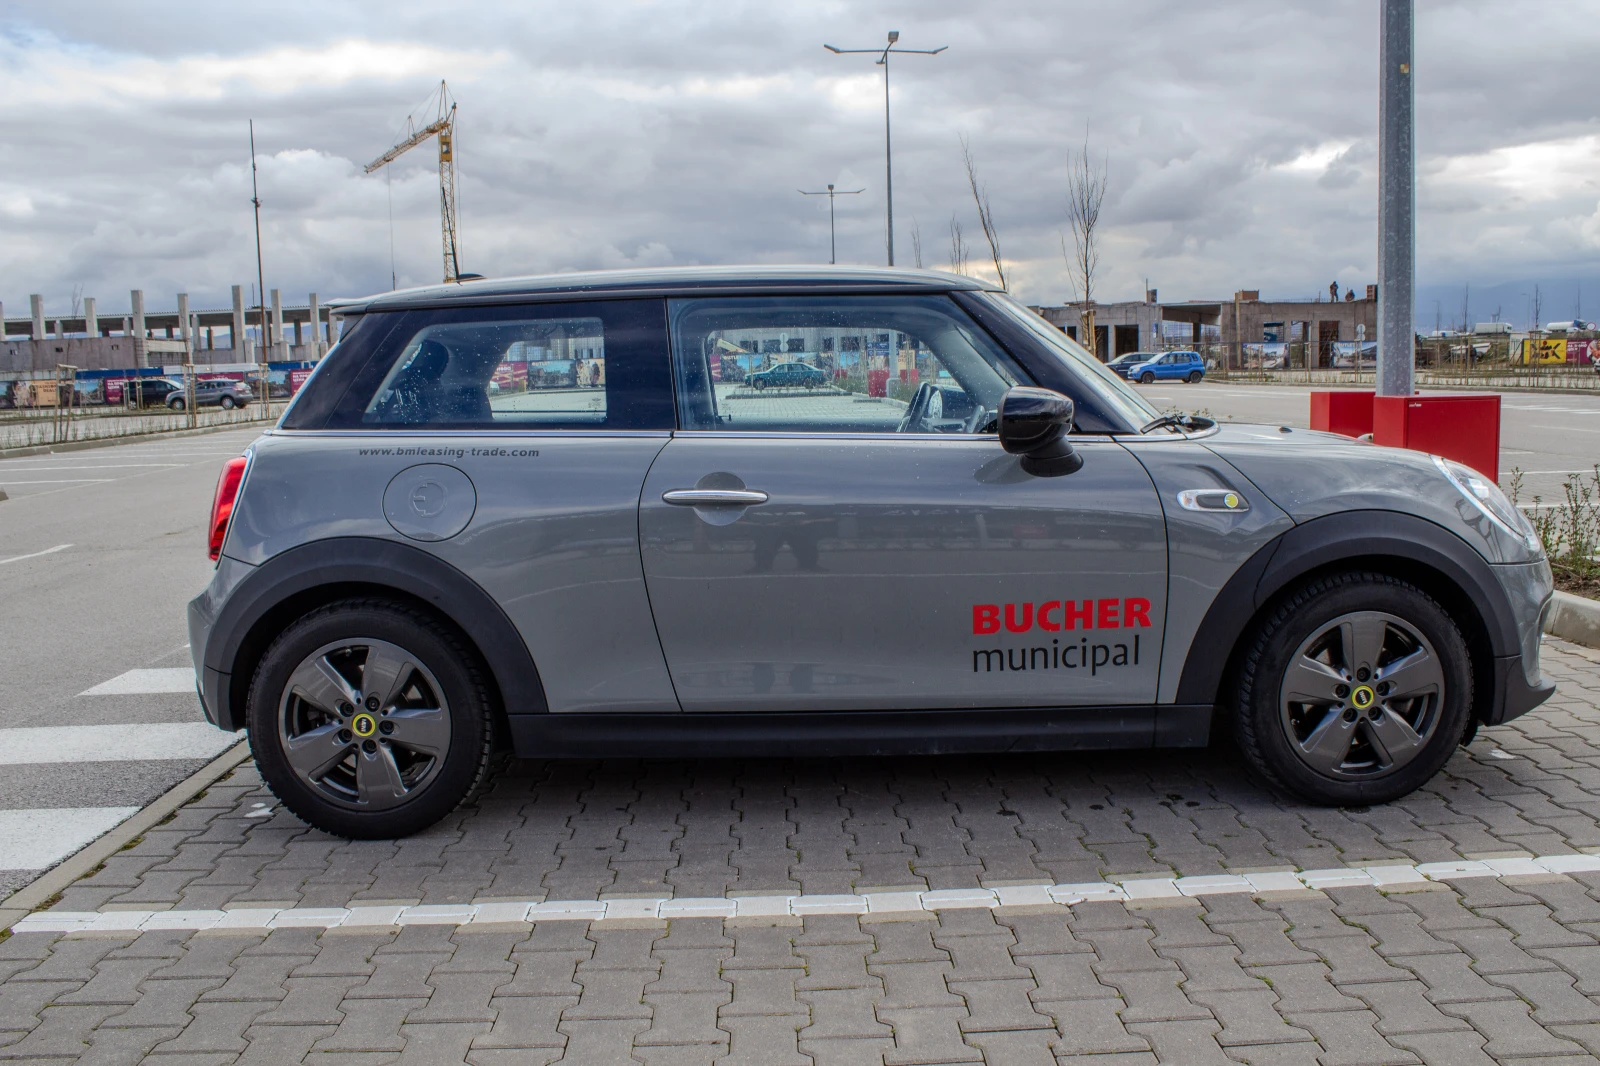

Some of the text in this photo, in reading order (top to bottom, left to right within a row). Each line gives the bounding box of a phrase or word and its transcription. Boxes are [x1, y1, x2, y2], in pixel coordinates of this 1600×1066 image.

[359, 447, 540, 459] www.bmleasing-trade.com
[973, 597, 1152, 635] BUCHER
[973, 634, 1140, 676] municipal
